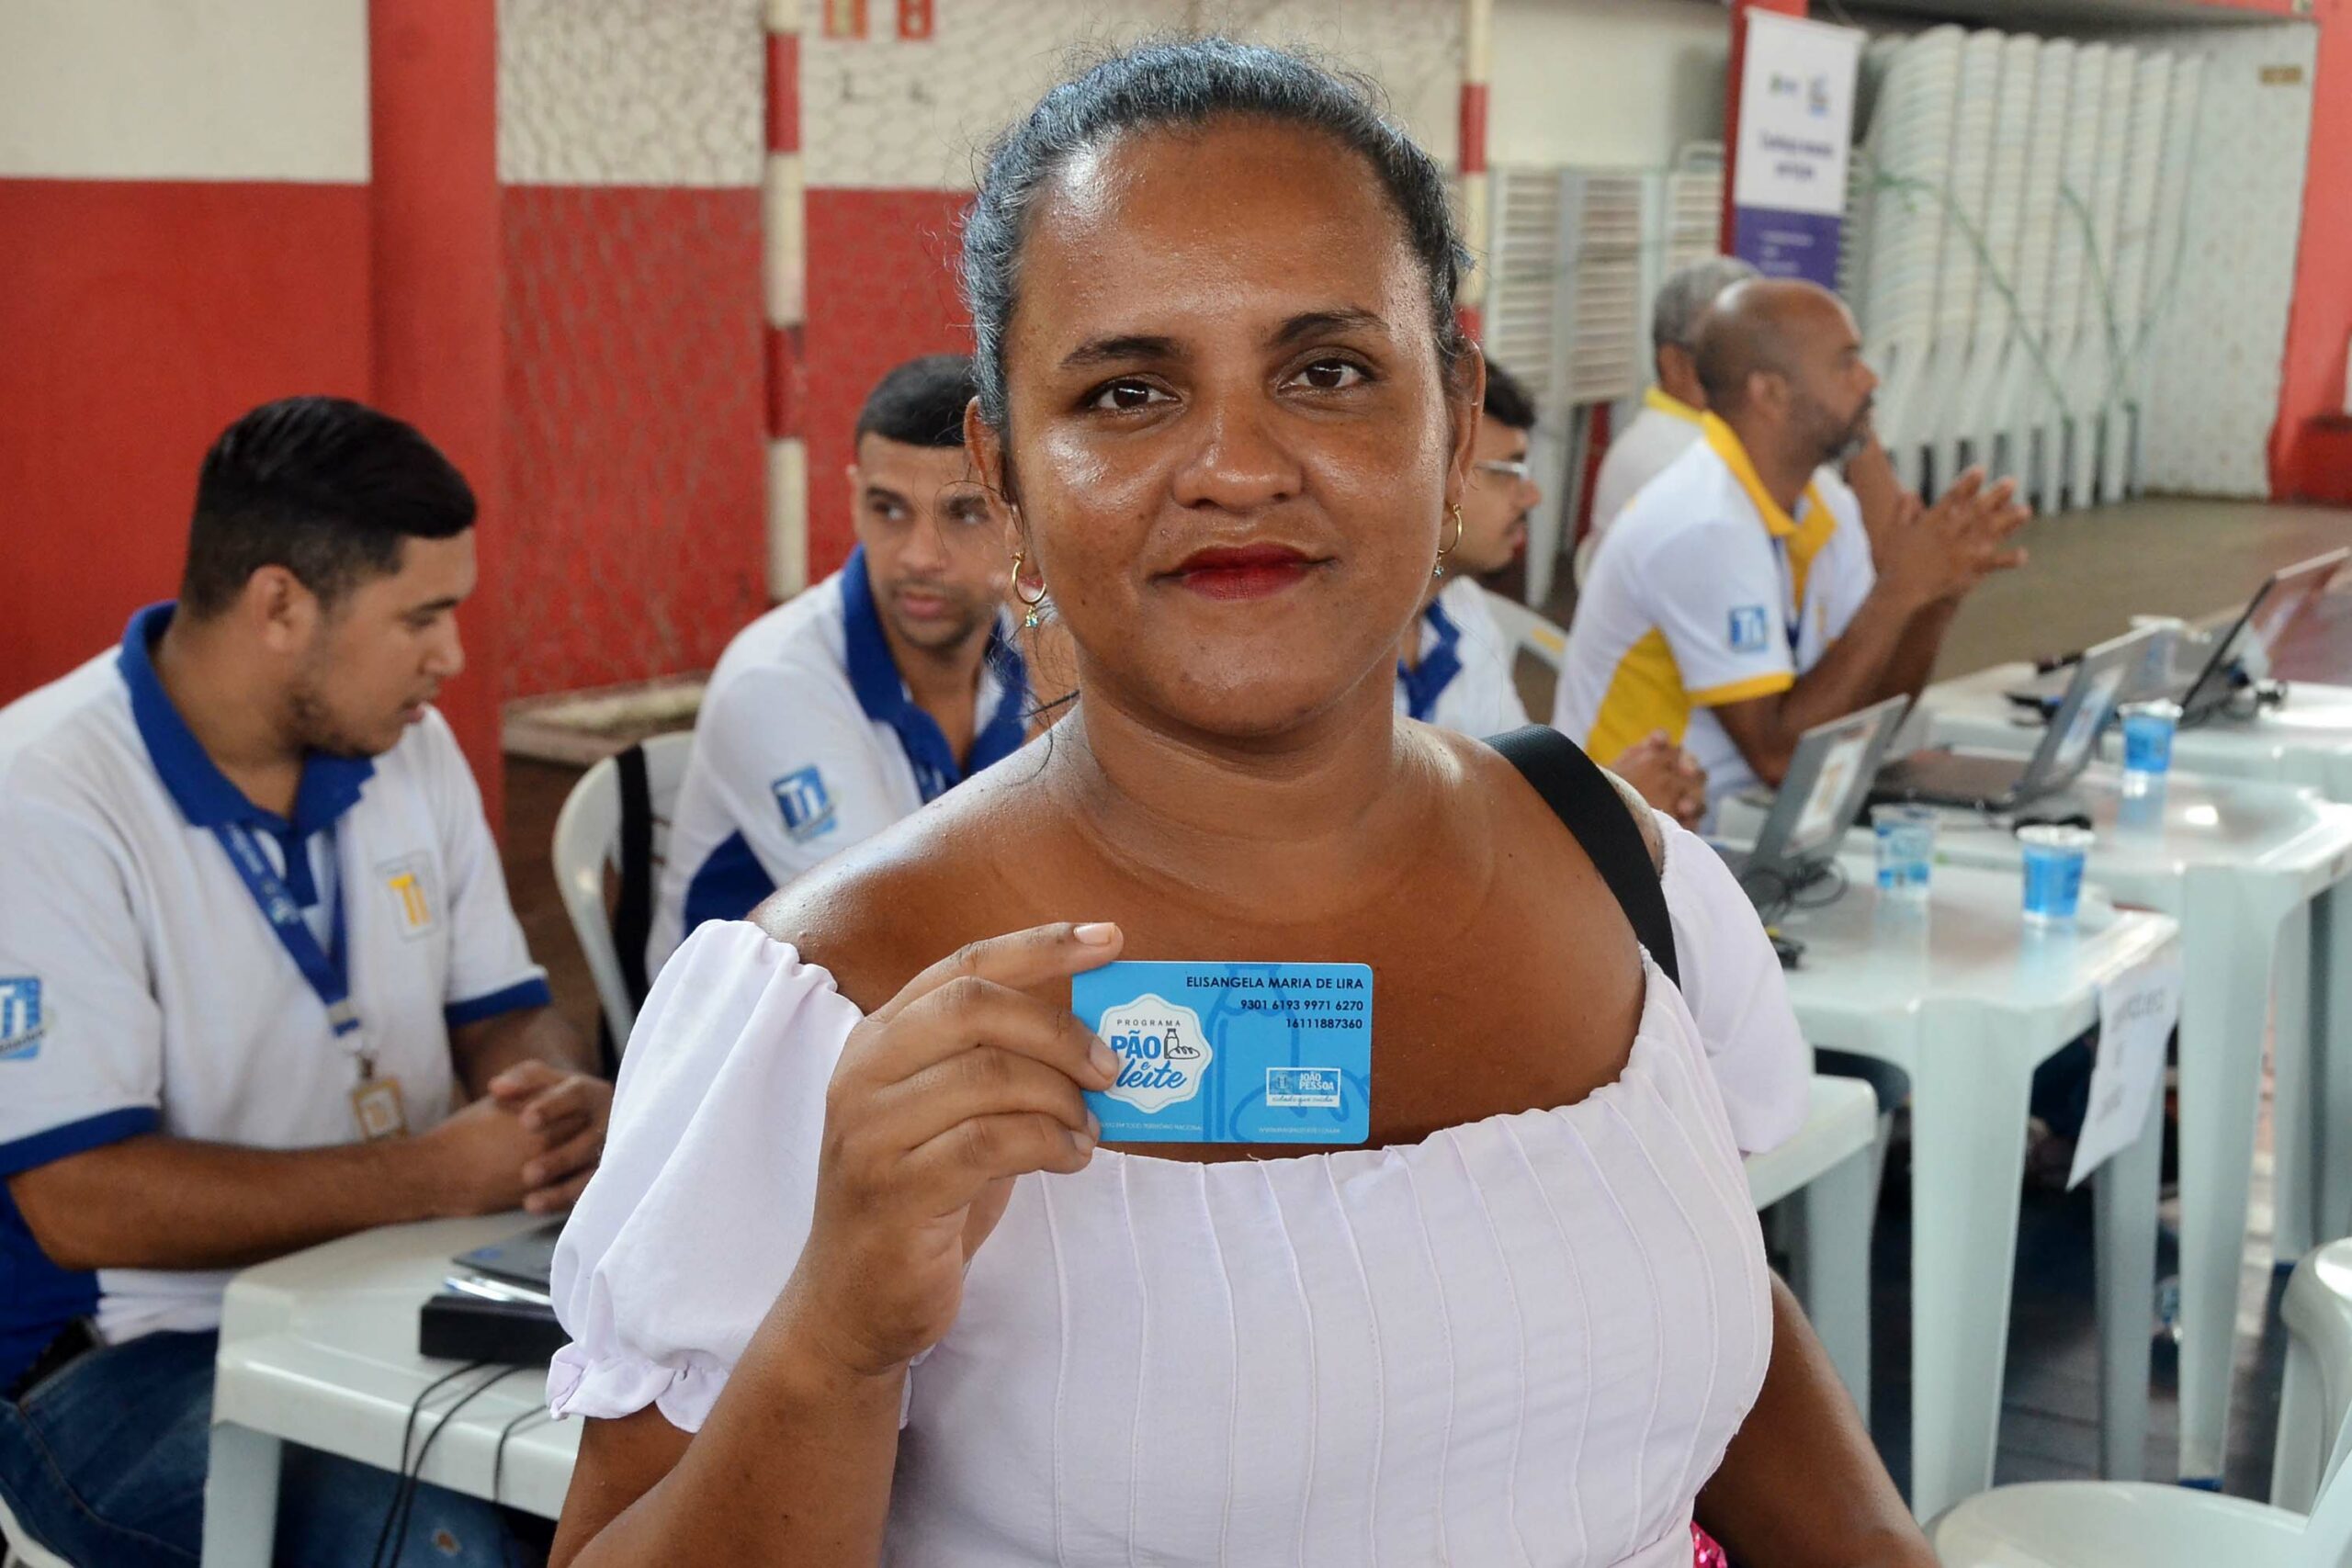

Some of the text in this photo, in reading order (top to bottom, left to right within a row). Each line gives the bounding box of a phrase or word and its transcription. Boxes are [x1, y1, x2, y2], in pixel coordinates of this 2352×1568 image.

[1186, 976, 1364, 989] ELISANGELA MARIA DE LIRA
[1240, 999, 1363, 1011] 9301 6193 9971 6270
[1116, 1019, 1182, 1027] PROGRAMA
[1286, 1018, 1363, 1030] 16111887360
[1110, 1029, 1162, 1060] PÃO
[1140, 1061, 1151, 1071] e
[1115, 1057, 1188, 1089] leite
[1298, 1080, 1334, 1091] PESSOA
